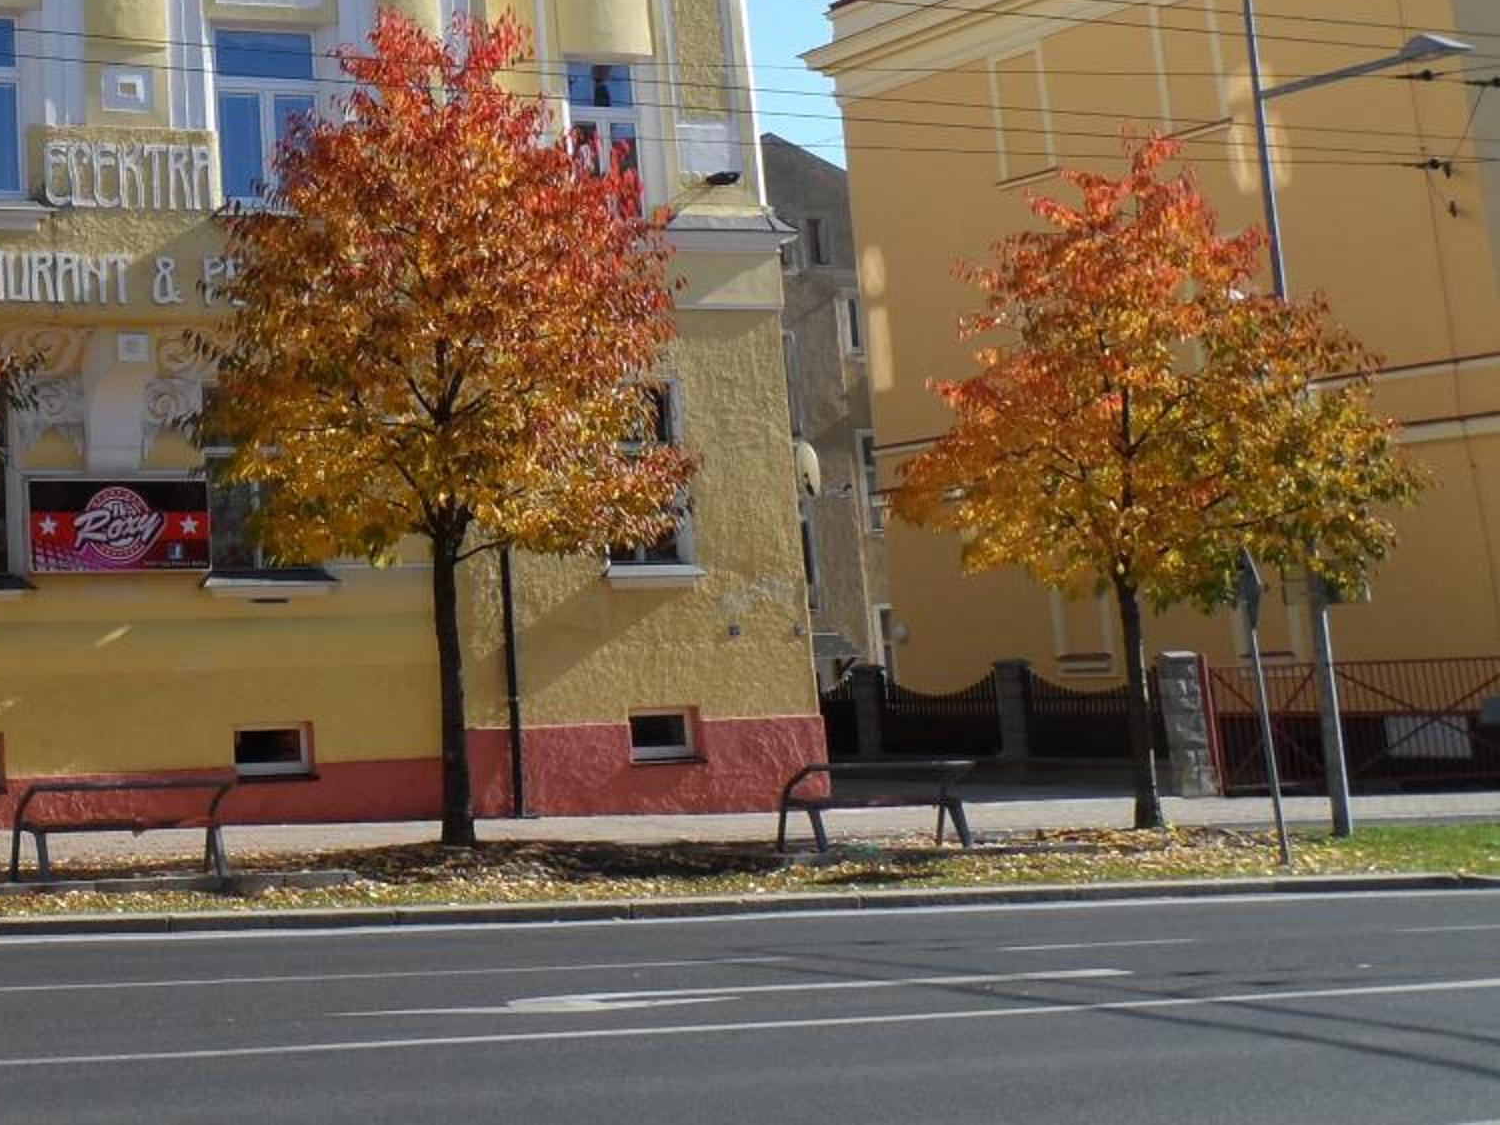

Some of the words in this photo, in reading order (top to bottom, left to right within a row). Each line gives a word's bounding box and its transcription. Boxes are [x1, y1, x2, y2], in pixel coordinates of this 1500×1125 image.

[44, 140, 215, 210] ELEKTRA
[153, 256, 185, 304] &
[73, 509, 162, 549] Roxy
